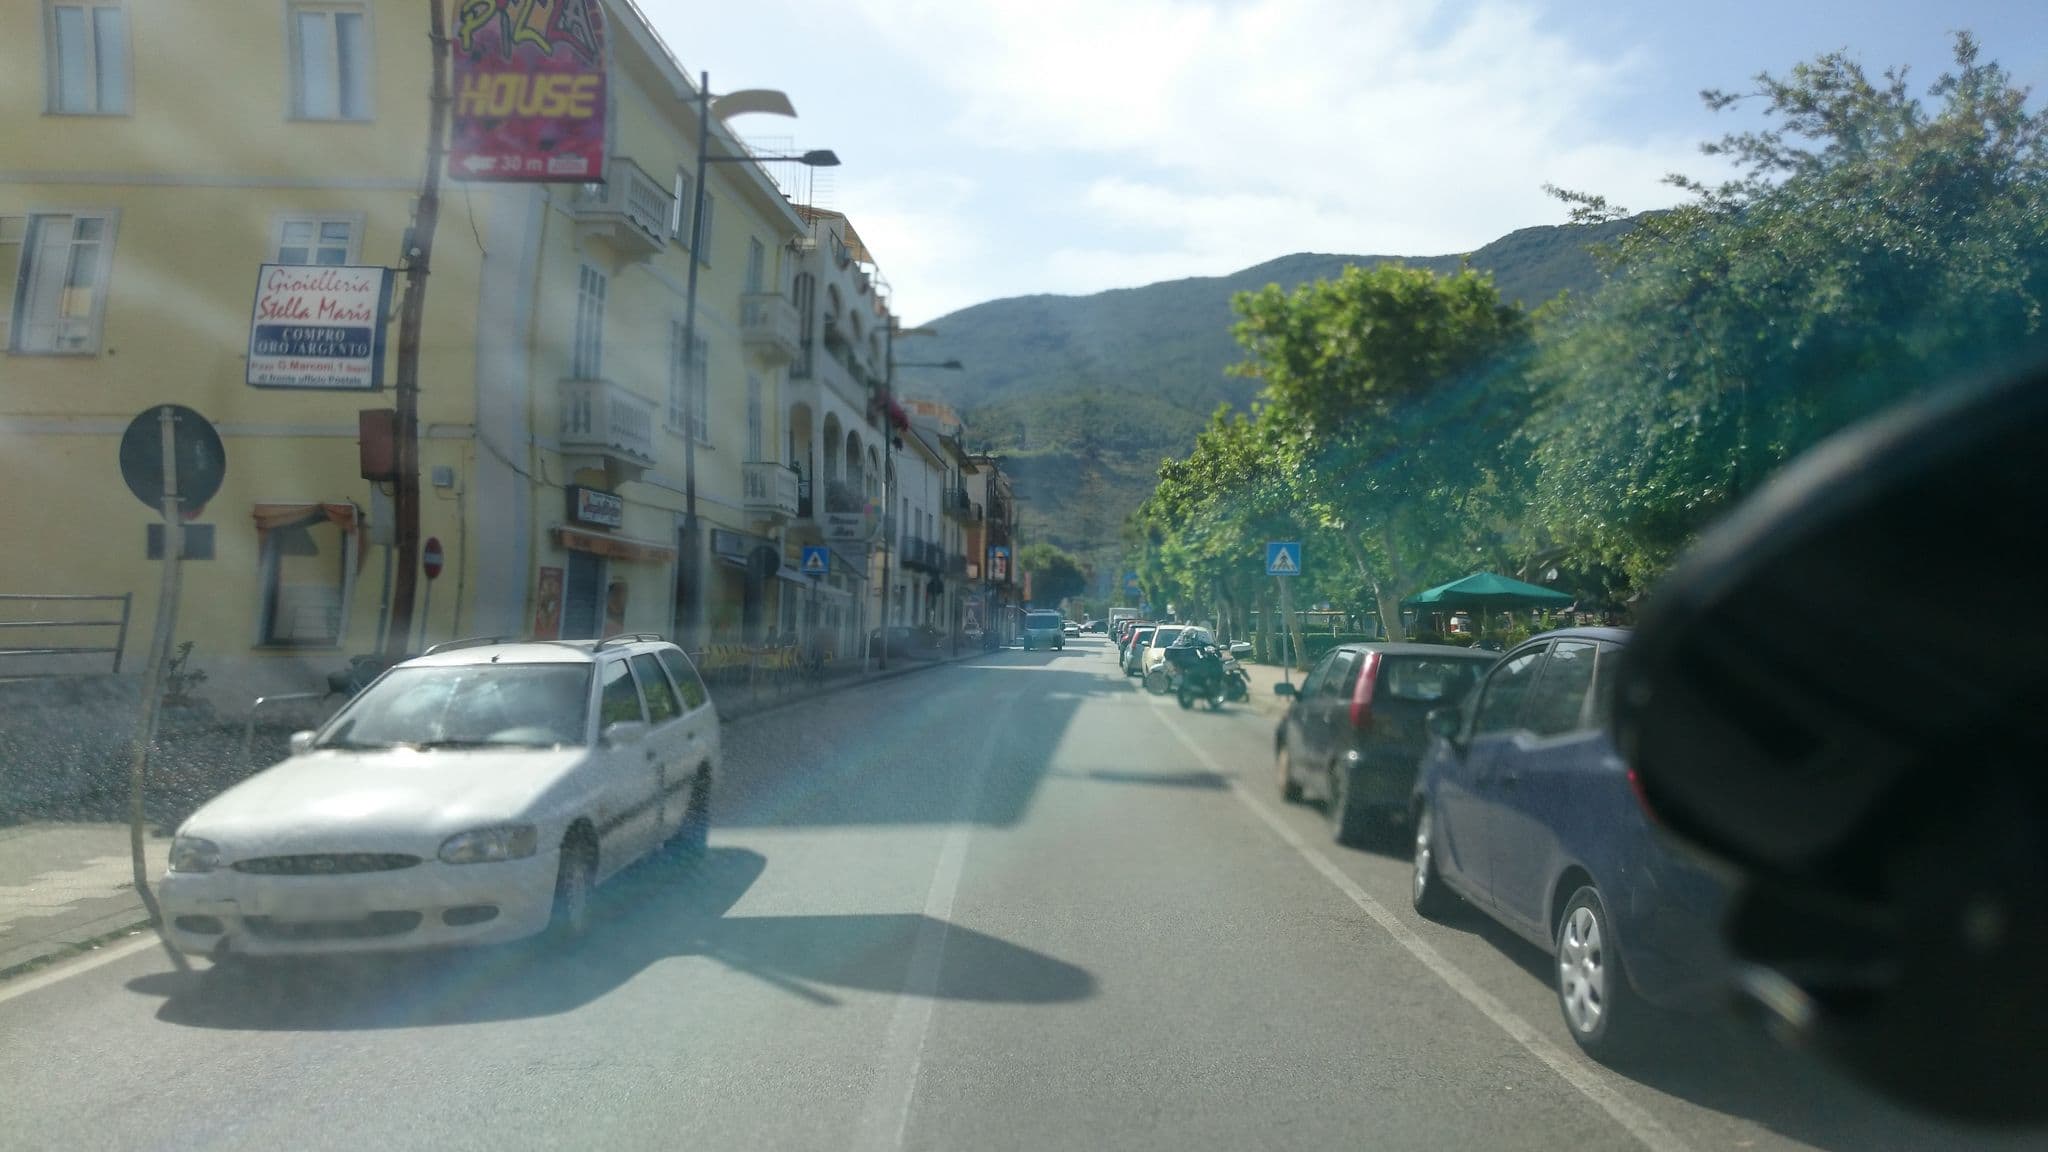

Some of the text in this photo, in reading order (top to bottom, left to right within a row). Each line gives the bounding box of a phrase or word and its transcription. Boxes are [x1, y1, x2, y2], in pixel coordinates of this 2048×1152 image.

[458, 71, 599, 119] HOUSE
[267, 268, 370, 295] Gioielleria
[258, 295, 371, 321] Stella Maris
[282, 327, 346, 342] COMPRO
